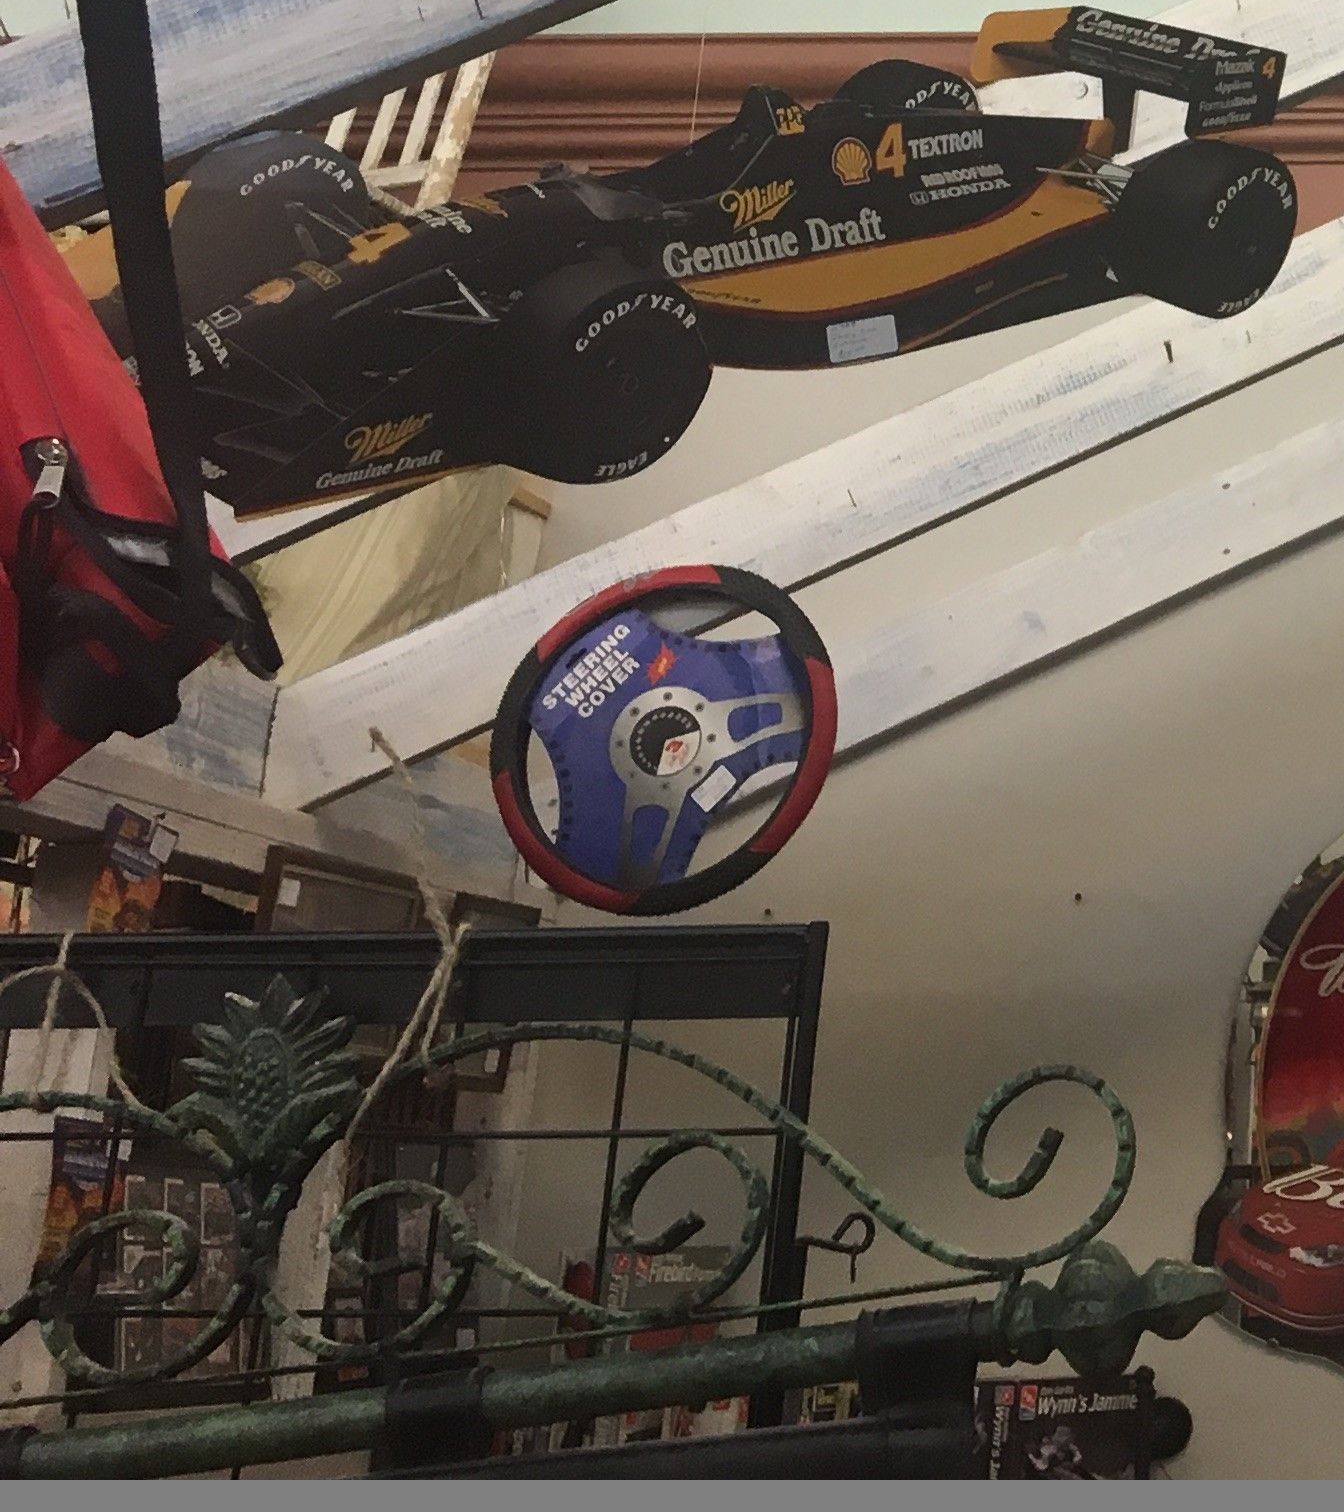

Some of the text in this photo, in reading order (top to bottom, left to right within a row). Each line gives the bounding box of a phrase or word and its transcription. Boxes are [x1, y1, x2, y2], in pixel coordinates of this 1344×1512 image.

[1261, 56, 1277, 79] 4
[875, 121, 908, 179] 4
[908, 128, 984, 161] TEXTRON
[719, 178, 797, 233] Miller
[929, 178, 1012, 202] HONDA
[347, 221, 412, 264] 4
[662, 206, 887, 279] Genuine Draft
[575, 292, 698, 352] GOODYEAR
[344, 411, 434, 462] Miller
[315, 447, 445, 490] Genuine Draft
[542, 624, 631, 710] STEERING
[564, 649, 630, 707] WHEEL
[577, 656, 640, 718] COVER
[1038, 1394, 1088, 1419] Wynn's
